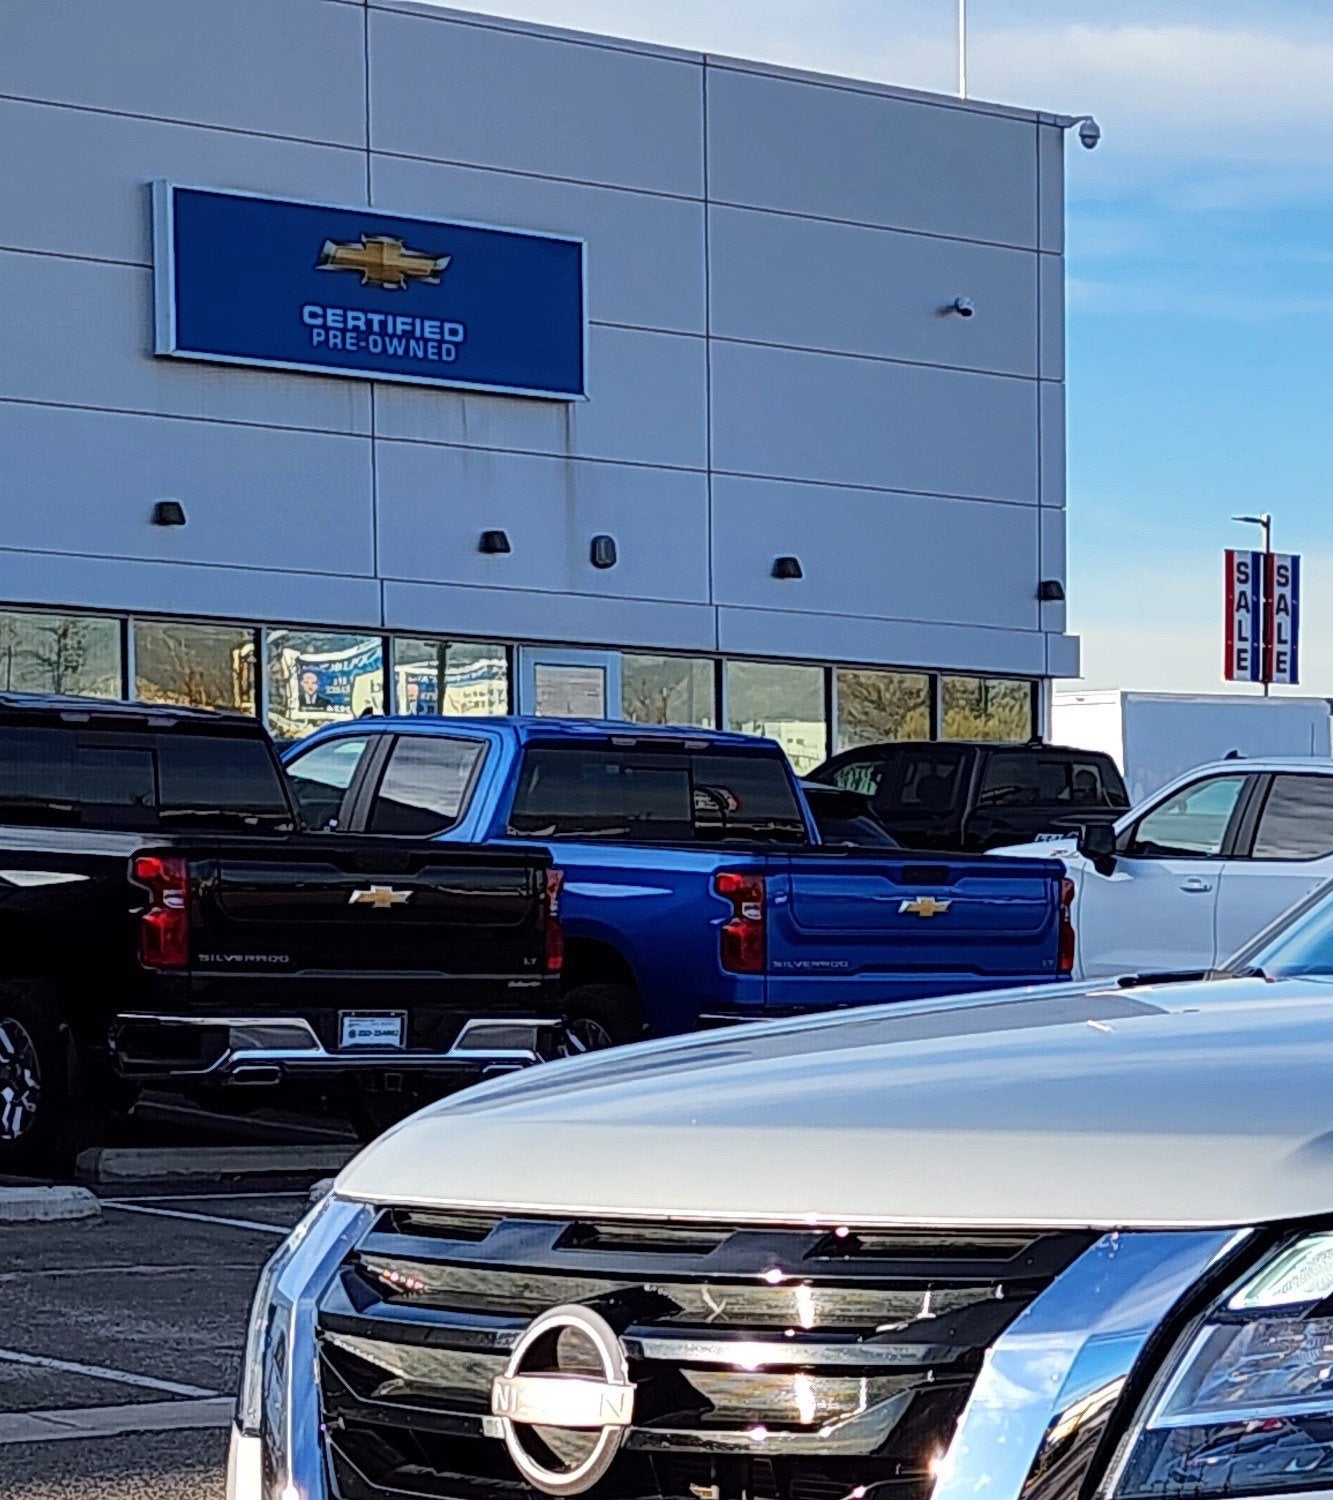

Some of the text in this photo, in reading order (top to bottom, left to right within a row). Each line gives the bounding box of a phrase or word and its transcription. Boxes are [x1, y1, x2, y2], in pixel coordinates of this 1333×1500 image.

[302, 305, 465, 343] CERTIFIED
[312, 328, 457, 362] PRE-OWNED
[1235, 561, 1251, 671] SALE
[1275, 564, 1290, 674] SALE
